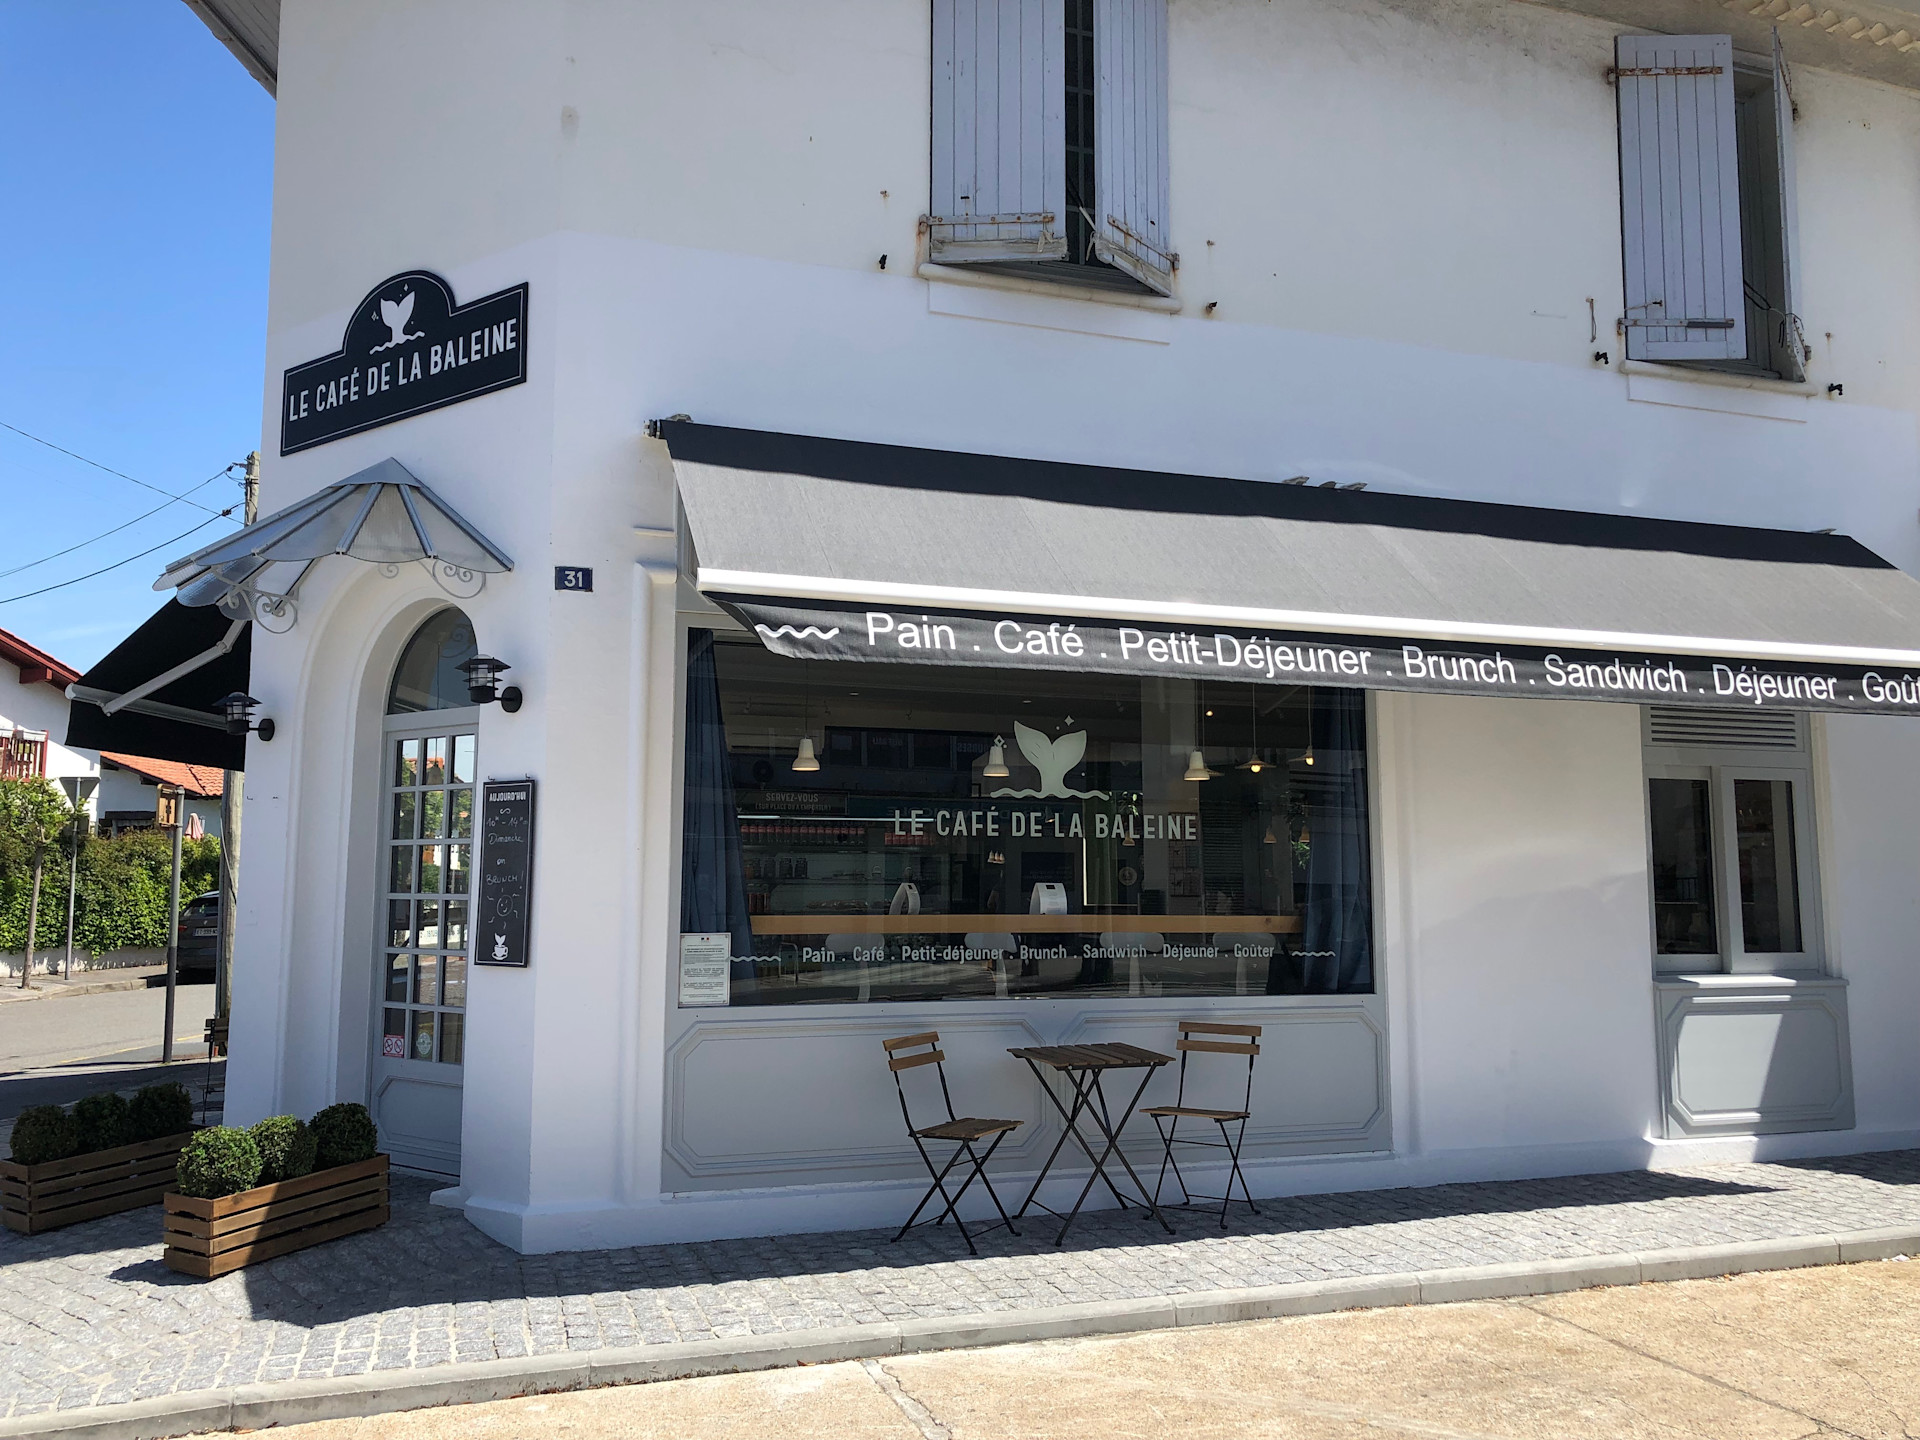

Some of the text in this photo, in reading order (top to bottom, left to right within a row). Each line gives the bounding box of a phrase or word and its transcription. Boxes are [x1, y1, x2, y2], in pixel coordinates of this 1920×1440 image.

[289, 318, 517, 421] LE CAFÉ DE LA BALEINE
[564, 570, 583, 588] 31
[865, 611, 956, 651] Pain
[994, 619, 1084, 657] Café
[1119, 627, 1371, 679] Petit-Déjeuner
[1402, 645, 1517, 684] Brunch
[1543, 653, 1688, 694] Sandwich
[1711, 663, 1838, 705] Déjeuner
[489, 791, 526, 802] AUJOURD'HUI
[765, 792, 819, 802] SERVEZ-VOUS
[893, 809, 924, 836] LE
[936, 805, 999, 837] CAFÉ
[1011, 812, 1042, 837] DE
[1054, 812, 1084, 838] LA
[1095, 813, 1197, 840] BALEINE
[488, 832, 525, 845] Dimanche
[802, 943, 1275, 964] Pain Café Petit-déjeuner Brunch Sandwich Déjeuner Goûter
